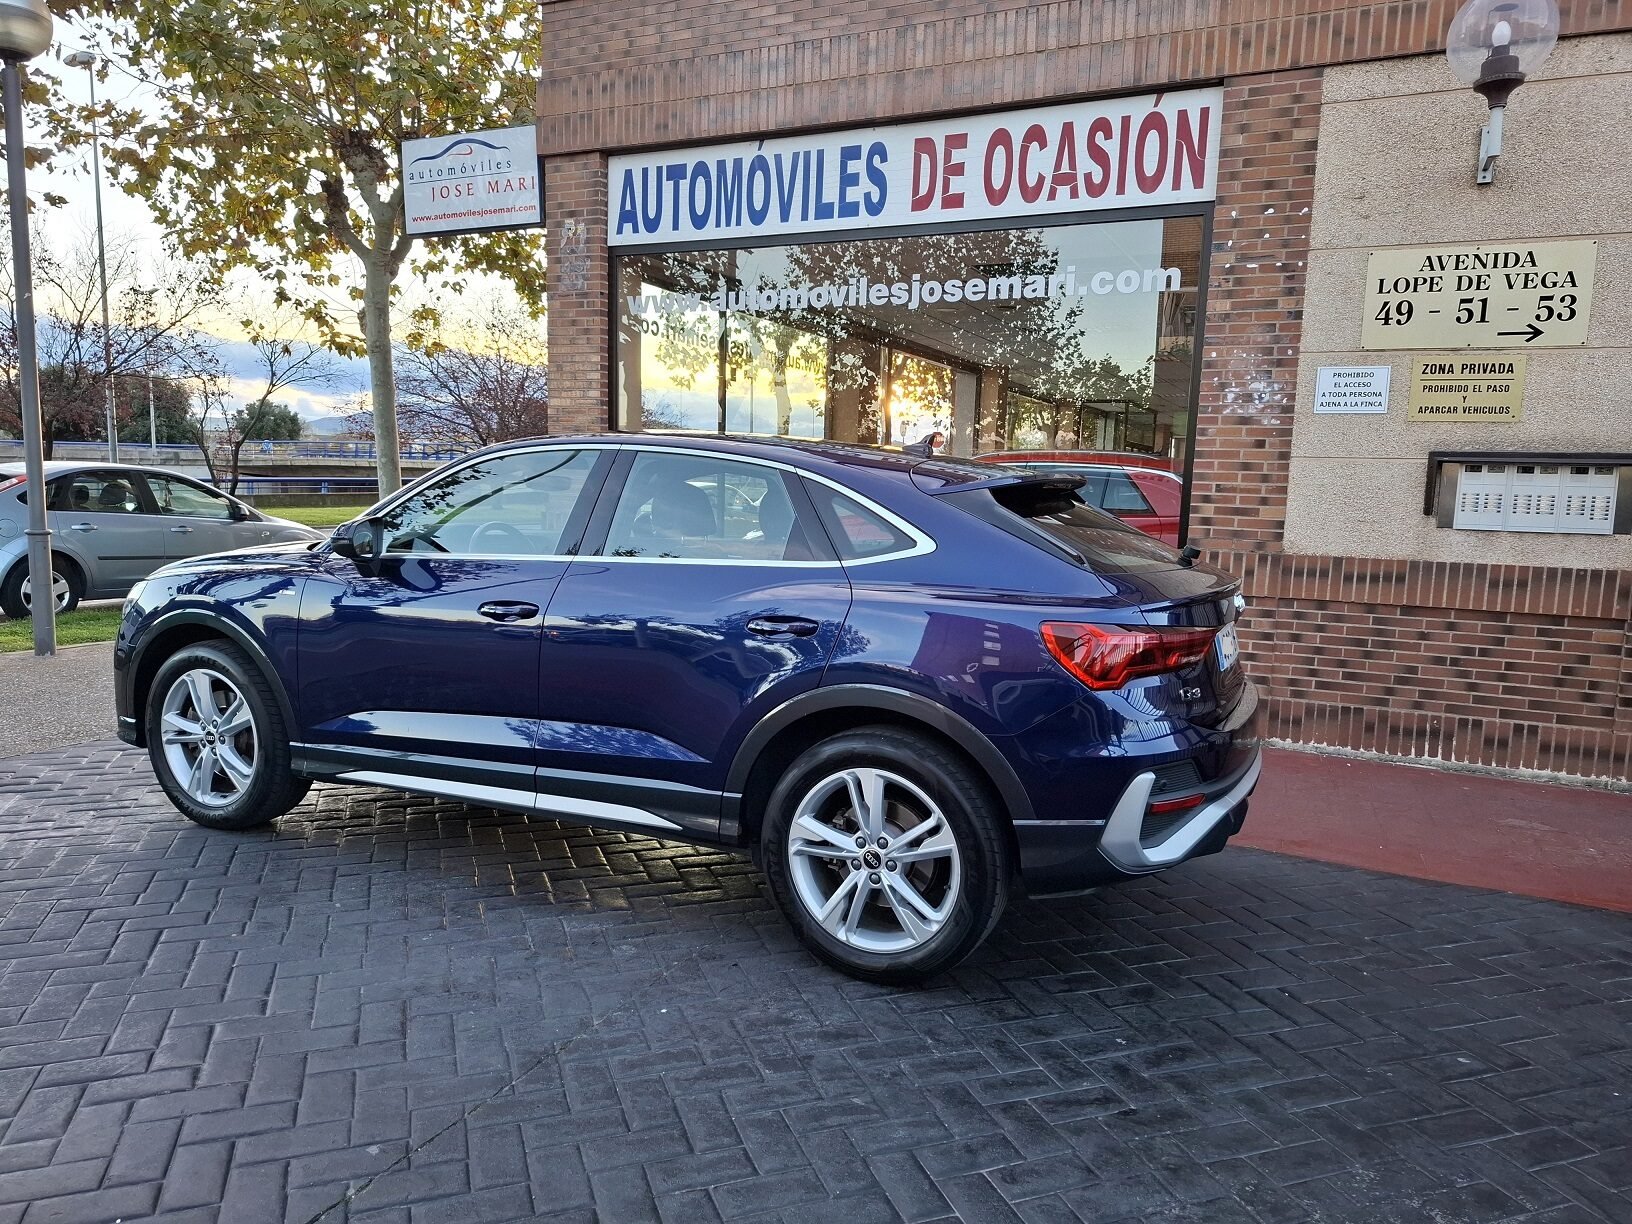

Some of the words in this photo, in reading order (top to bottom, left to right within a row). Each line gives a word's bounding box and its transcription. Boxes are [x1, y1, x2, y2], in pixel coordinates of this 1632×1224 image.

[409, 160, 511, 181] automóviles
[616, 140, 888, 235] AUTOMÓVILES
[911, 133, 968, 212] DE
[983, 92, 1210, 203] OCASIÓN
[432, 183, 474, 202] JOSE
[488, 176, 536, 194] MARI
[411, 205, 537, 223] www.automovilesjosemari.com
[1419, 251, 1538, 272] AVENIDA
[627, 266, 1182, 315] www.automovilesjosemari.com
[1377, 276, 1443, 295] LOPE
[1456, 274, 1491, 292] DE
[1504, 271, 1578, 290] VEGA
[1375, 300, 1413, 326] 49
[1456, 297, 1490, 324] 51
[1535, 294, 1577, 322] 53
[1422, 364, 1454, 374] ZONA
[1461, 363, 1514, 374] PRIVADA
[1423, 385, 1469, 393] PROHIBIDO
[1473, 385, 1482, 393] EL
[1486, 385, 1510, 393] PASO
[1418, 406, 1458, 414] APARCAR
[1462, 406, 1511, 414] VEHICULOS
